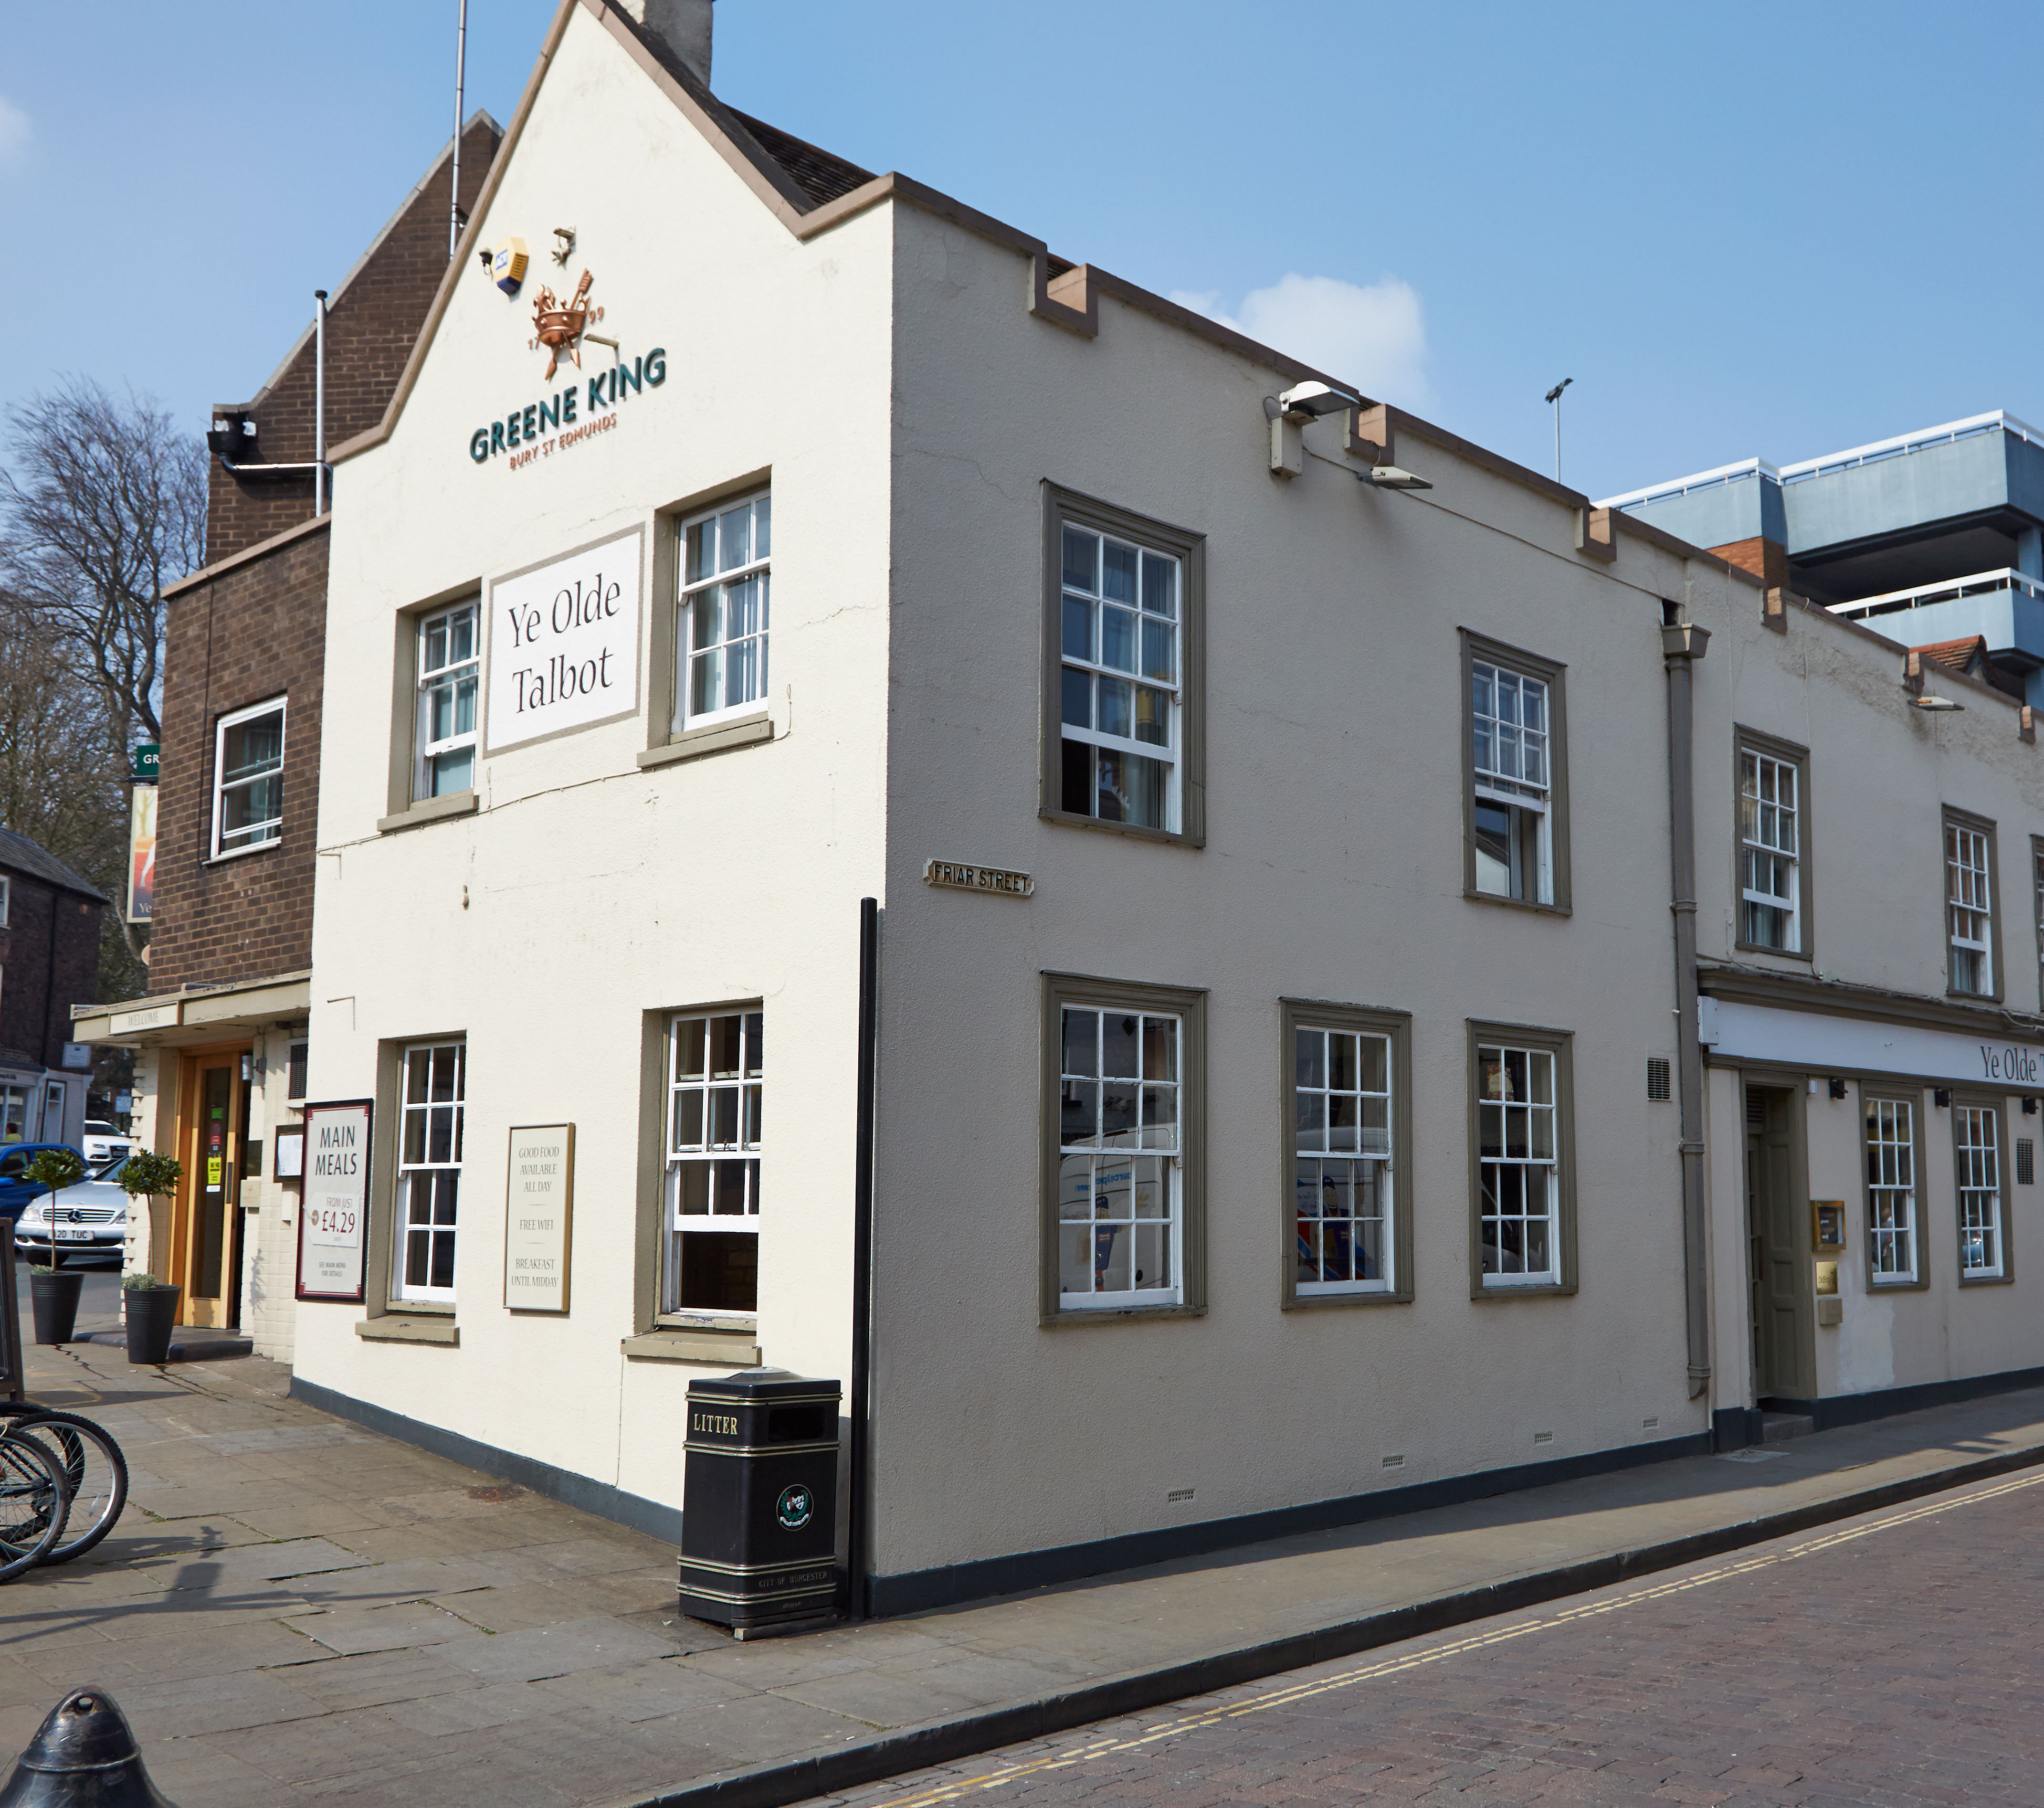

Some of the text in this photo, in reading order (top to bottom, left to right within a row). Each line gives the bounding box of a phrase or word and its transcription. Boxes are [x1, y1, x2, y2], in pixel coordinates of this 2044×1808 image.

[470, 348, 665, 461] GREENE KING
[509, 413, 617, 469] BURY ST EDMUNDS
[508, 573, 620, 648] Ye Olde
[512, 646, 614, 713] Talbot
[933, 864, 1028, 892] FRIAR STREET
[128, 1011, 160, 1027] WELCOME
[1980, 1045, 1999, 1078] Ye
[2004, 1048, 2037, 1082] Olde
[320, 1126, 355, 1148] MAIN
[519, 1146, 559, 1158] GOOD FOOD
[315, 1153, 357, 1176] MEALS
[520, 1164, 557, 1175] AVAILABLE
[524, 1181, 552, 1192] ALL DAY
[326, 1197, 341, 1207] FROM
[322, 1211, 355, 1233] £4.29
[520, 1220, 553, 1230] FREE WIFI
[515, 1259, 555, 1270] BREAKFAST
[511, 1276, 559, 1287] UNTIL MIDDAY
[693, 1413, 737, 1435] LITTER
[759, 1571, 827, 1588] CITY OF WORCESTER
